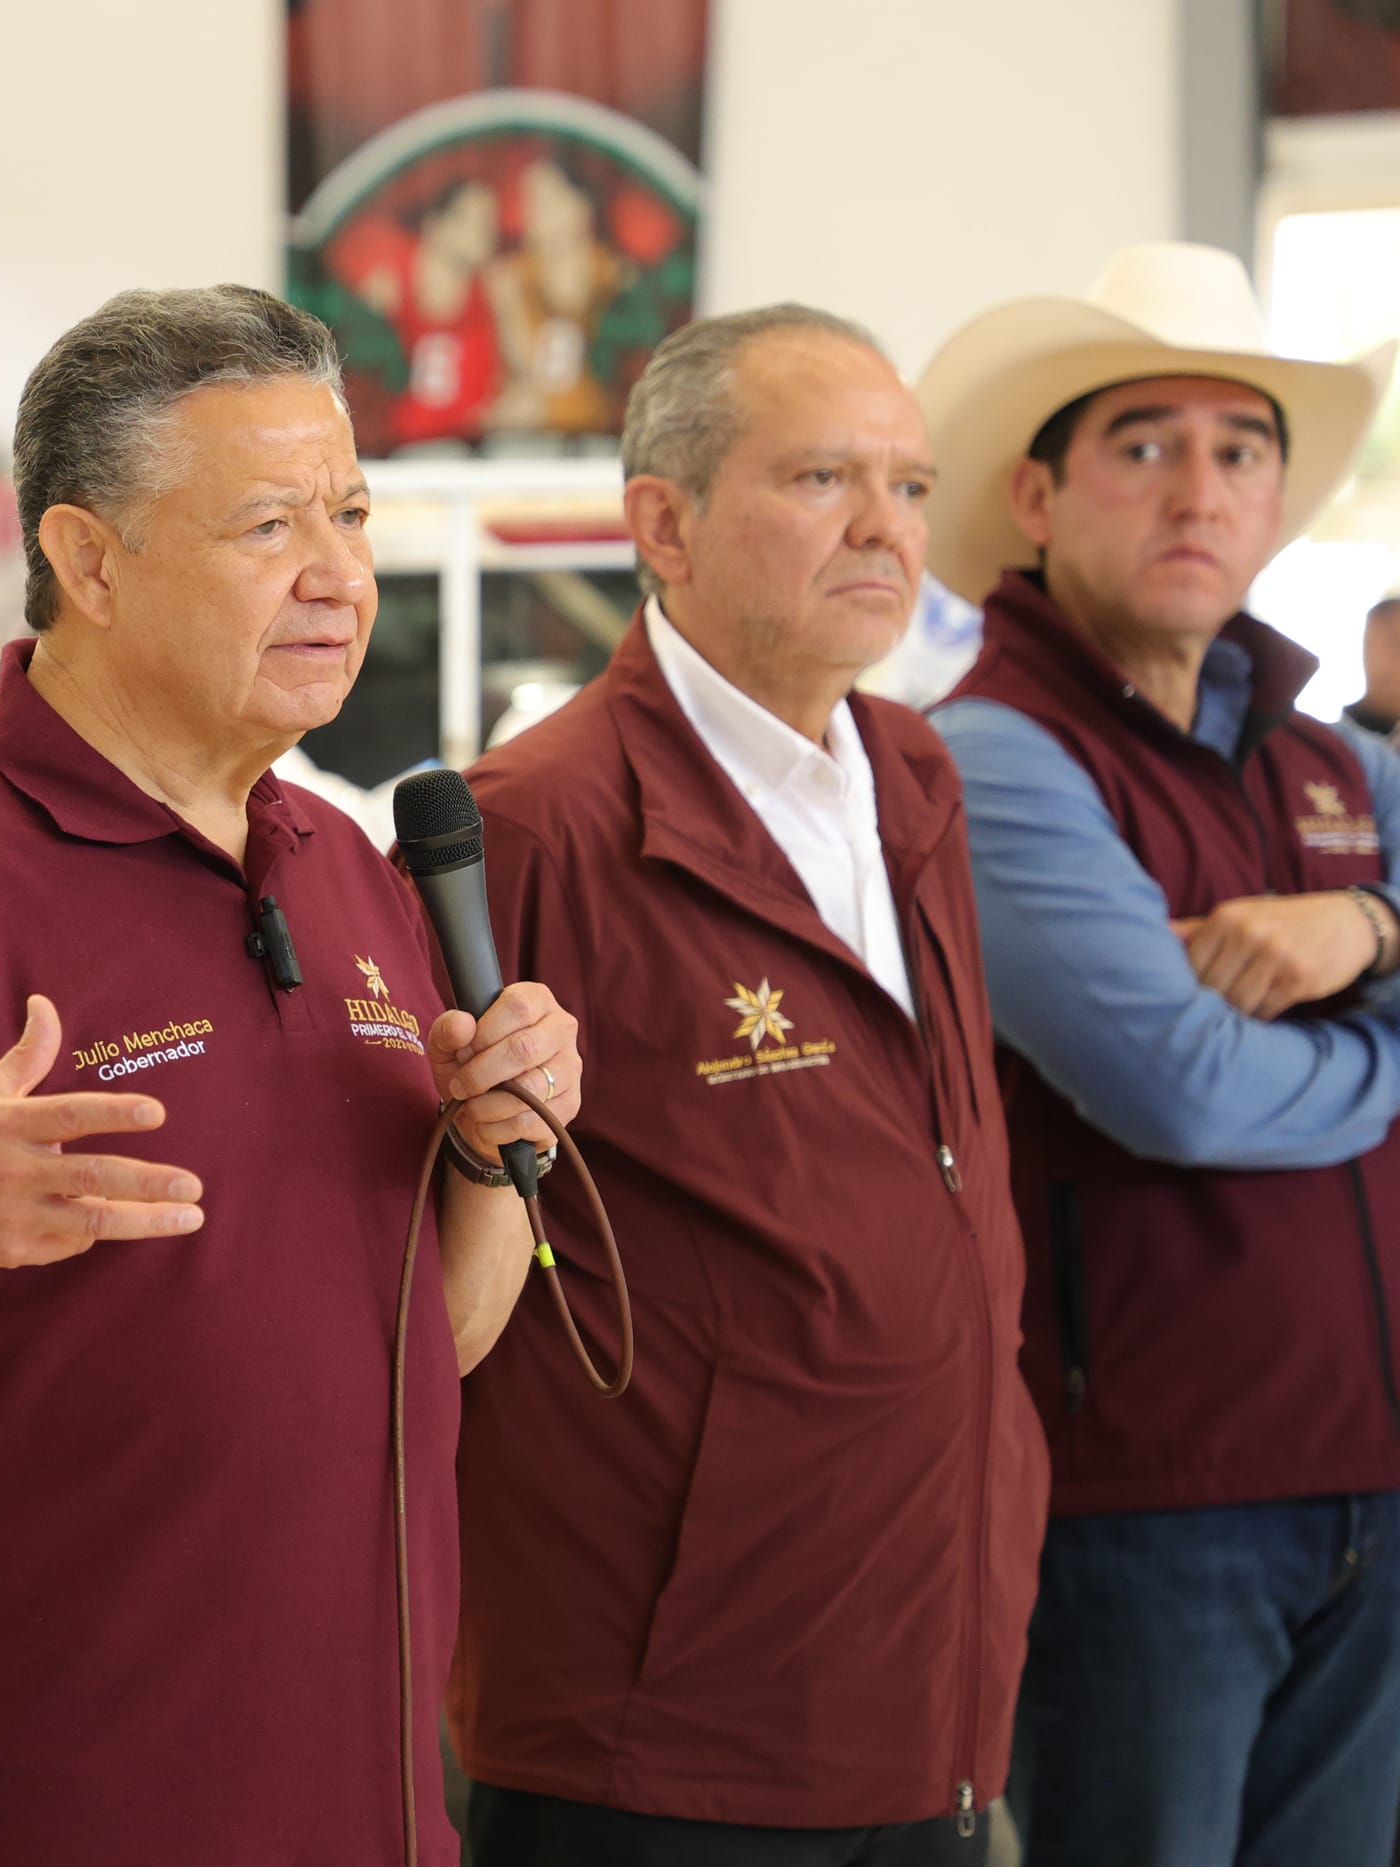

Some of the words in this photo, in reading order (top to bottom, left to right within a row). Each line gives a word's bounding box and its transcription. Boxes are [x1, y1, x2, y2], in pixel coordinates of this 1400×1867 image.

[72, 1040, 120, 1071] Julio
[123, 1018, 214, 1053] Menchaca
[98, 1040, 207, 1082] Gobernador
